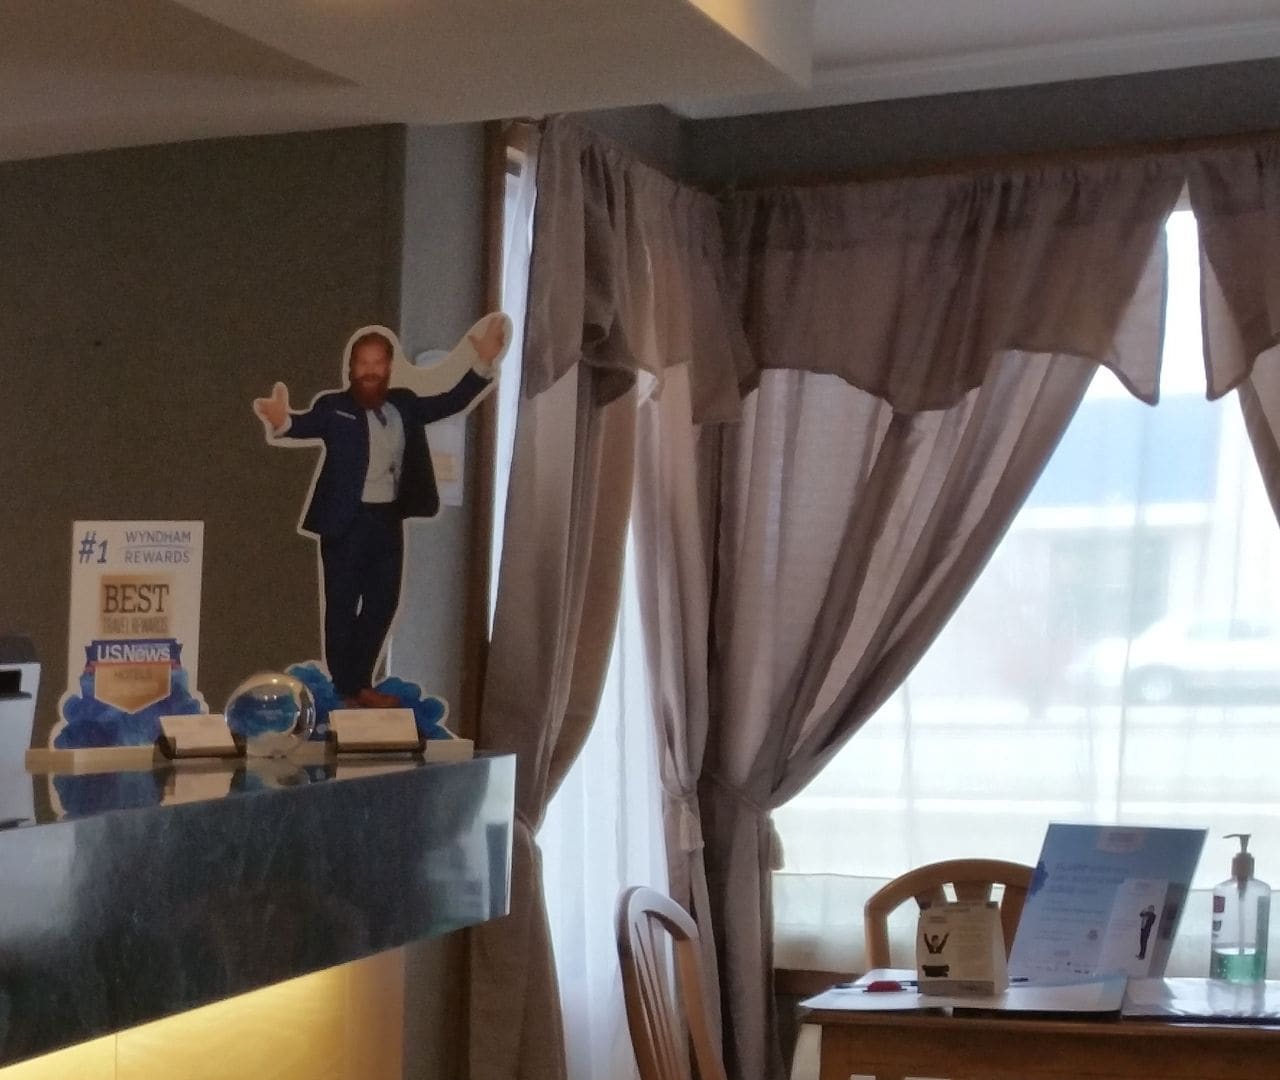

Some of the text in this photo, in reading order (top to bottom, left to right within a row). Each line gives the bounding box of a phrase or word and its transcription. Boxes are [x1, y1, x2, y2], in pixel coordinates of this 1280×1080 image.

[79, 531, 108, 564] #1
[125, 530, 192, 544] WYNDHAM
[124, 550, 191, 564] REWARDS
[103, 584, 170, 613] BEST
